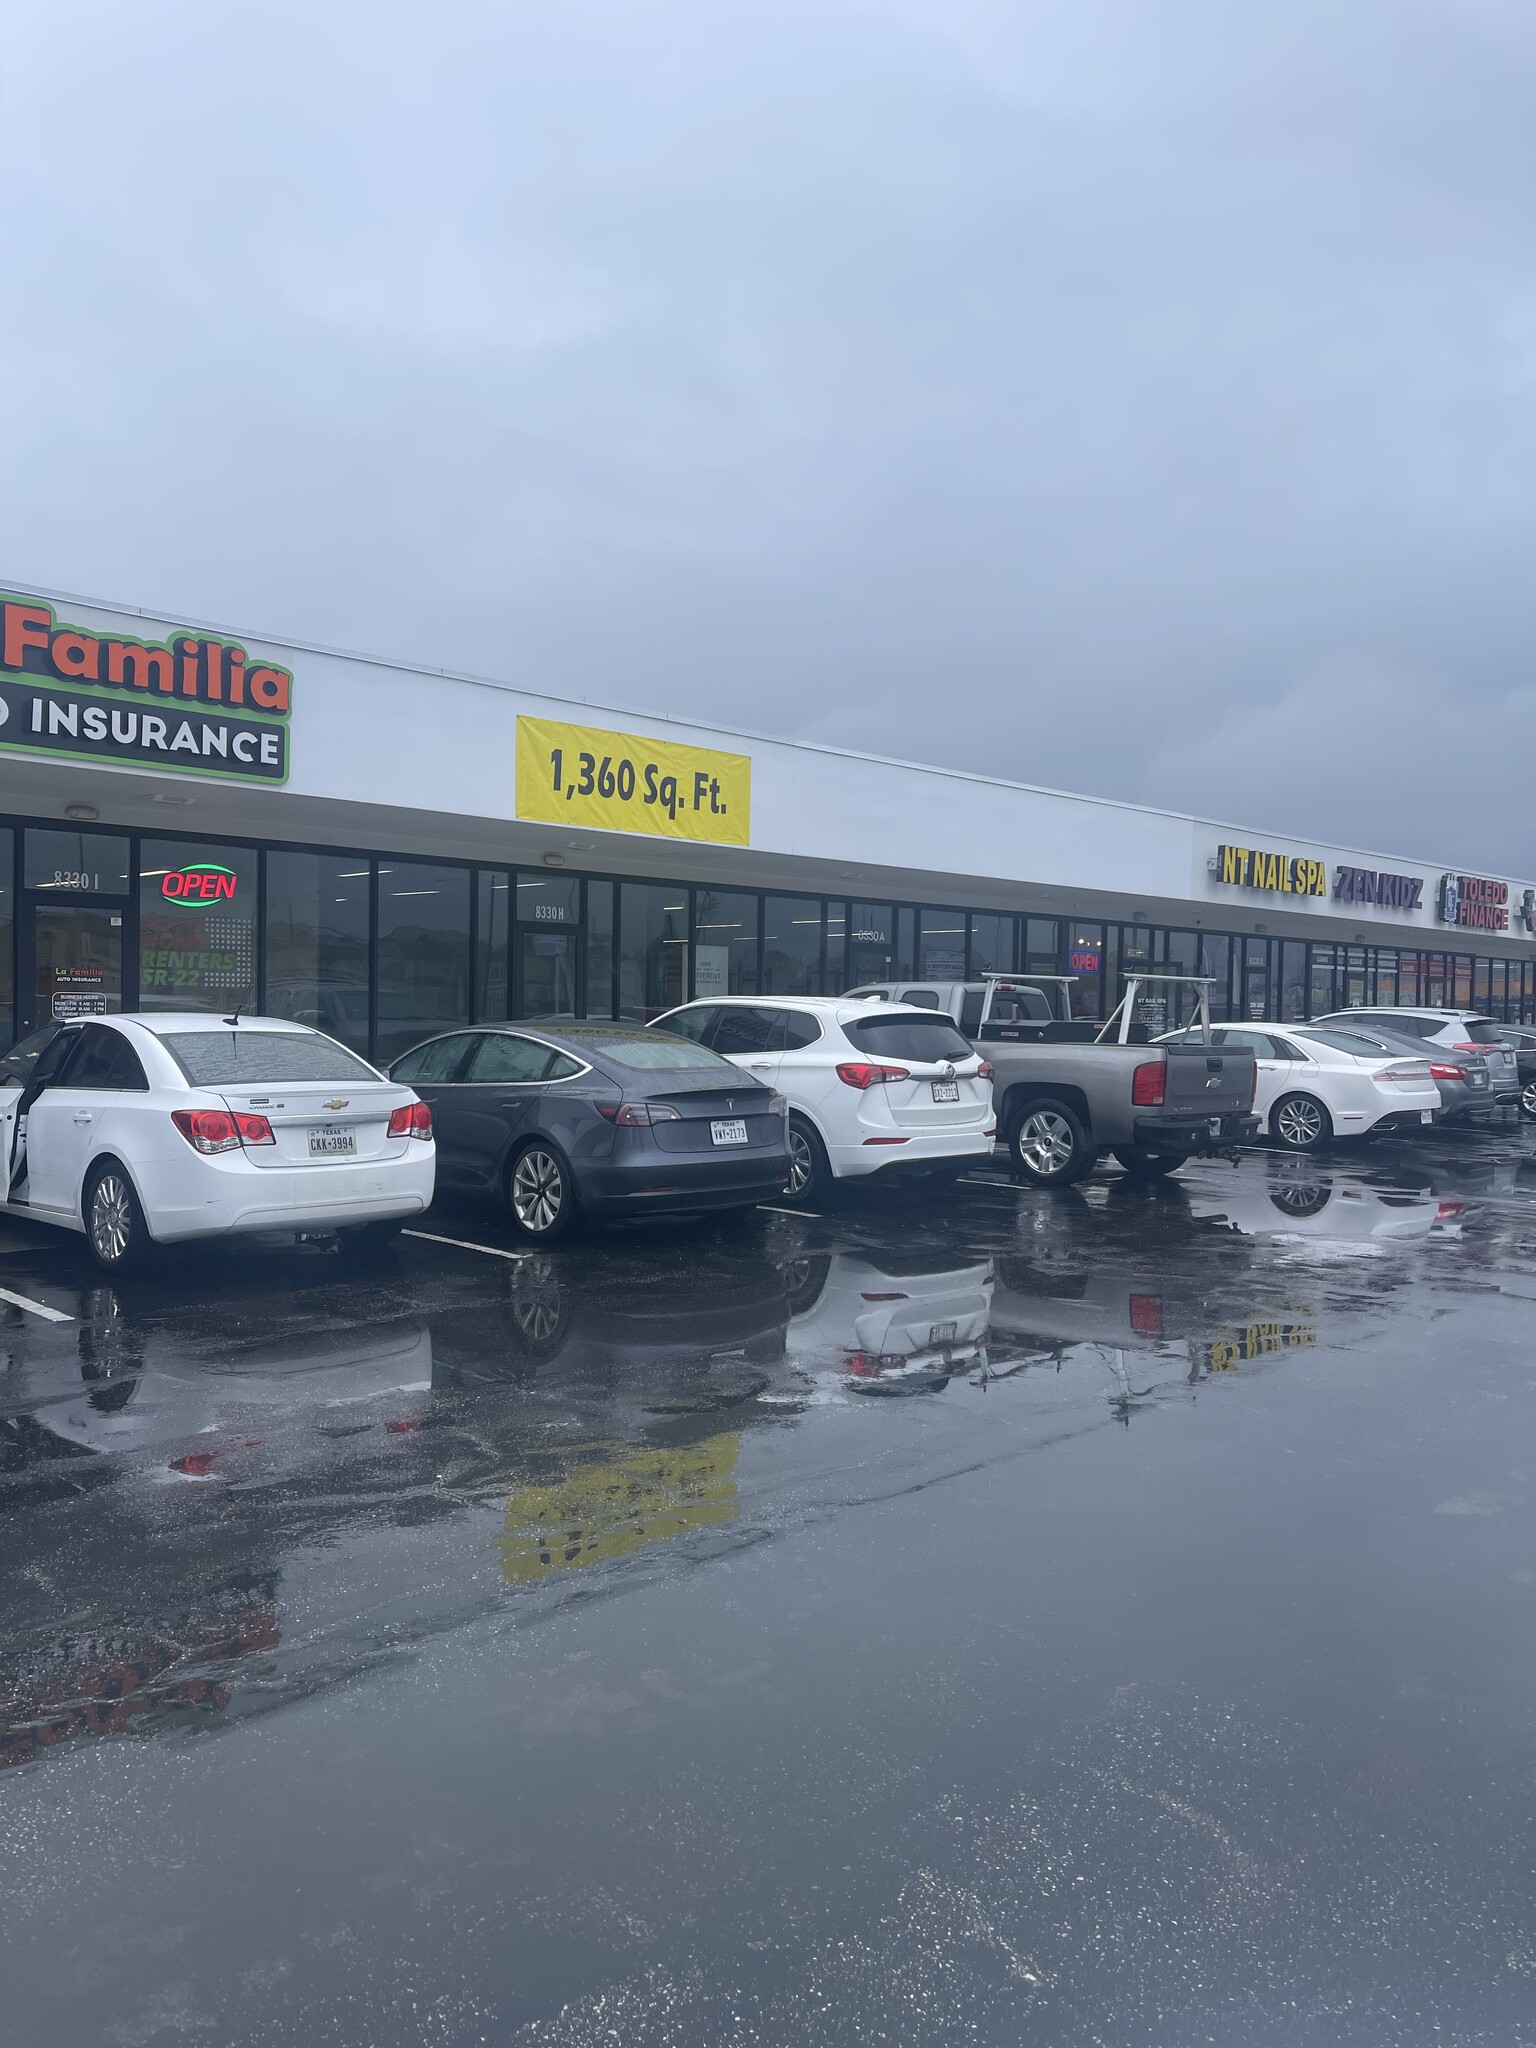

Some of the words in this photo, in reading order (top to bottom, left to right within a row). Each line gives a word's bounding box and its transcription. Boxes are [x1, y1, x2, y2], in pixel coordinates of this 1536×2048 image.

[4, 603, 289, 711] Familia
[32, 697, 279, 765] INSURANCE
[551, 748, 636, 801] 1,360
[643, 763, 685, 820] Sq.
[693, 772, 727, 814] Ft.
[53, 870, 90, 890] 8330
[1221, 845, 1249, 885] NT
[1252, 851, 1292, 892] NAIL
[1295, 857, 1326, 896] SPA
[161, 872, 237, 899] OPEN
[1336, 865, 1378, 903] ZEN
[1379, 873, 1424, 909] KIDZ
[1462, 876, 1509, 905] TOLEDO
[1459, 901, 1509, 930] FINANCE
[55, 967, 67, 975] La
[141, 949, 236, 970] RENTERS
[1071, 953, 1099, 971] OPEN
[141, 968, 201, 987] SR-22
